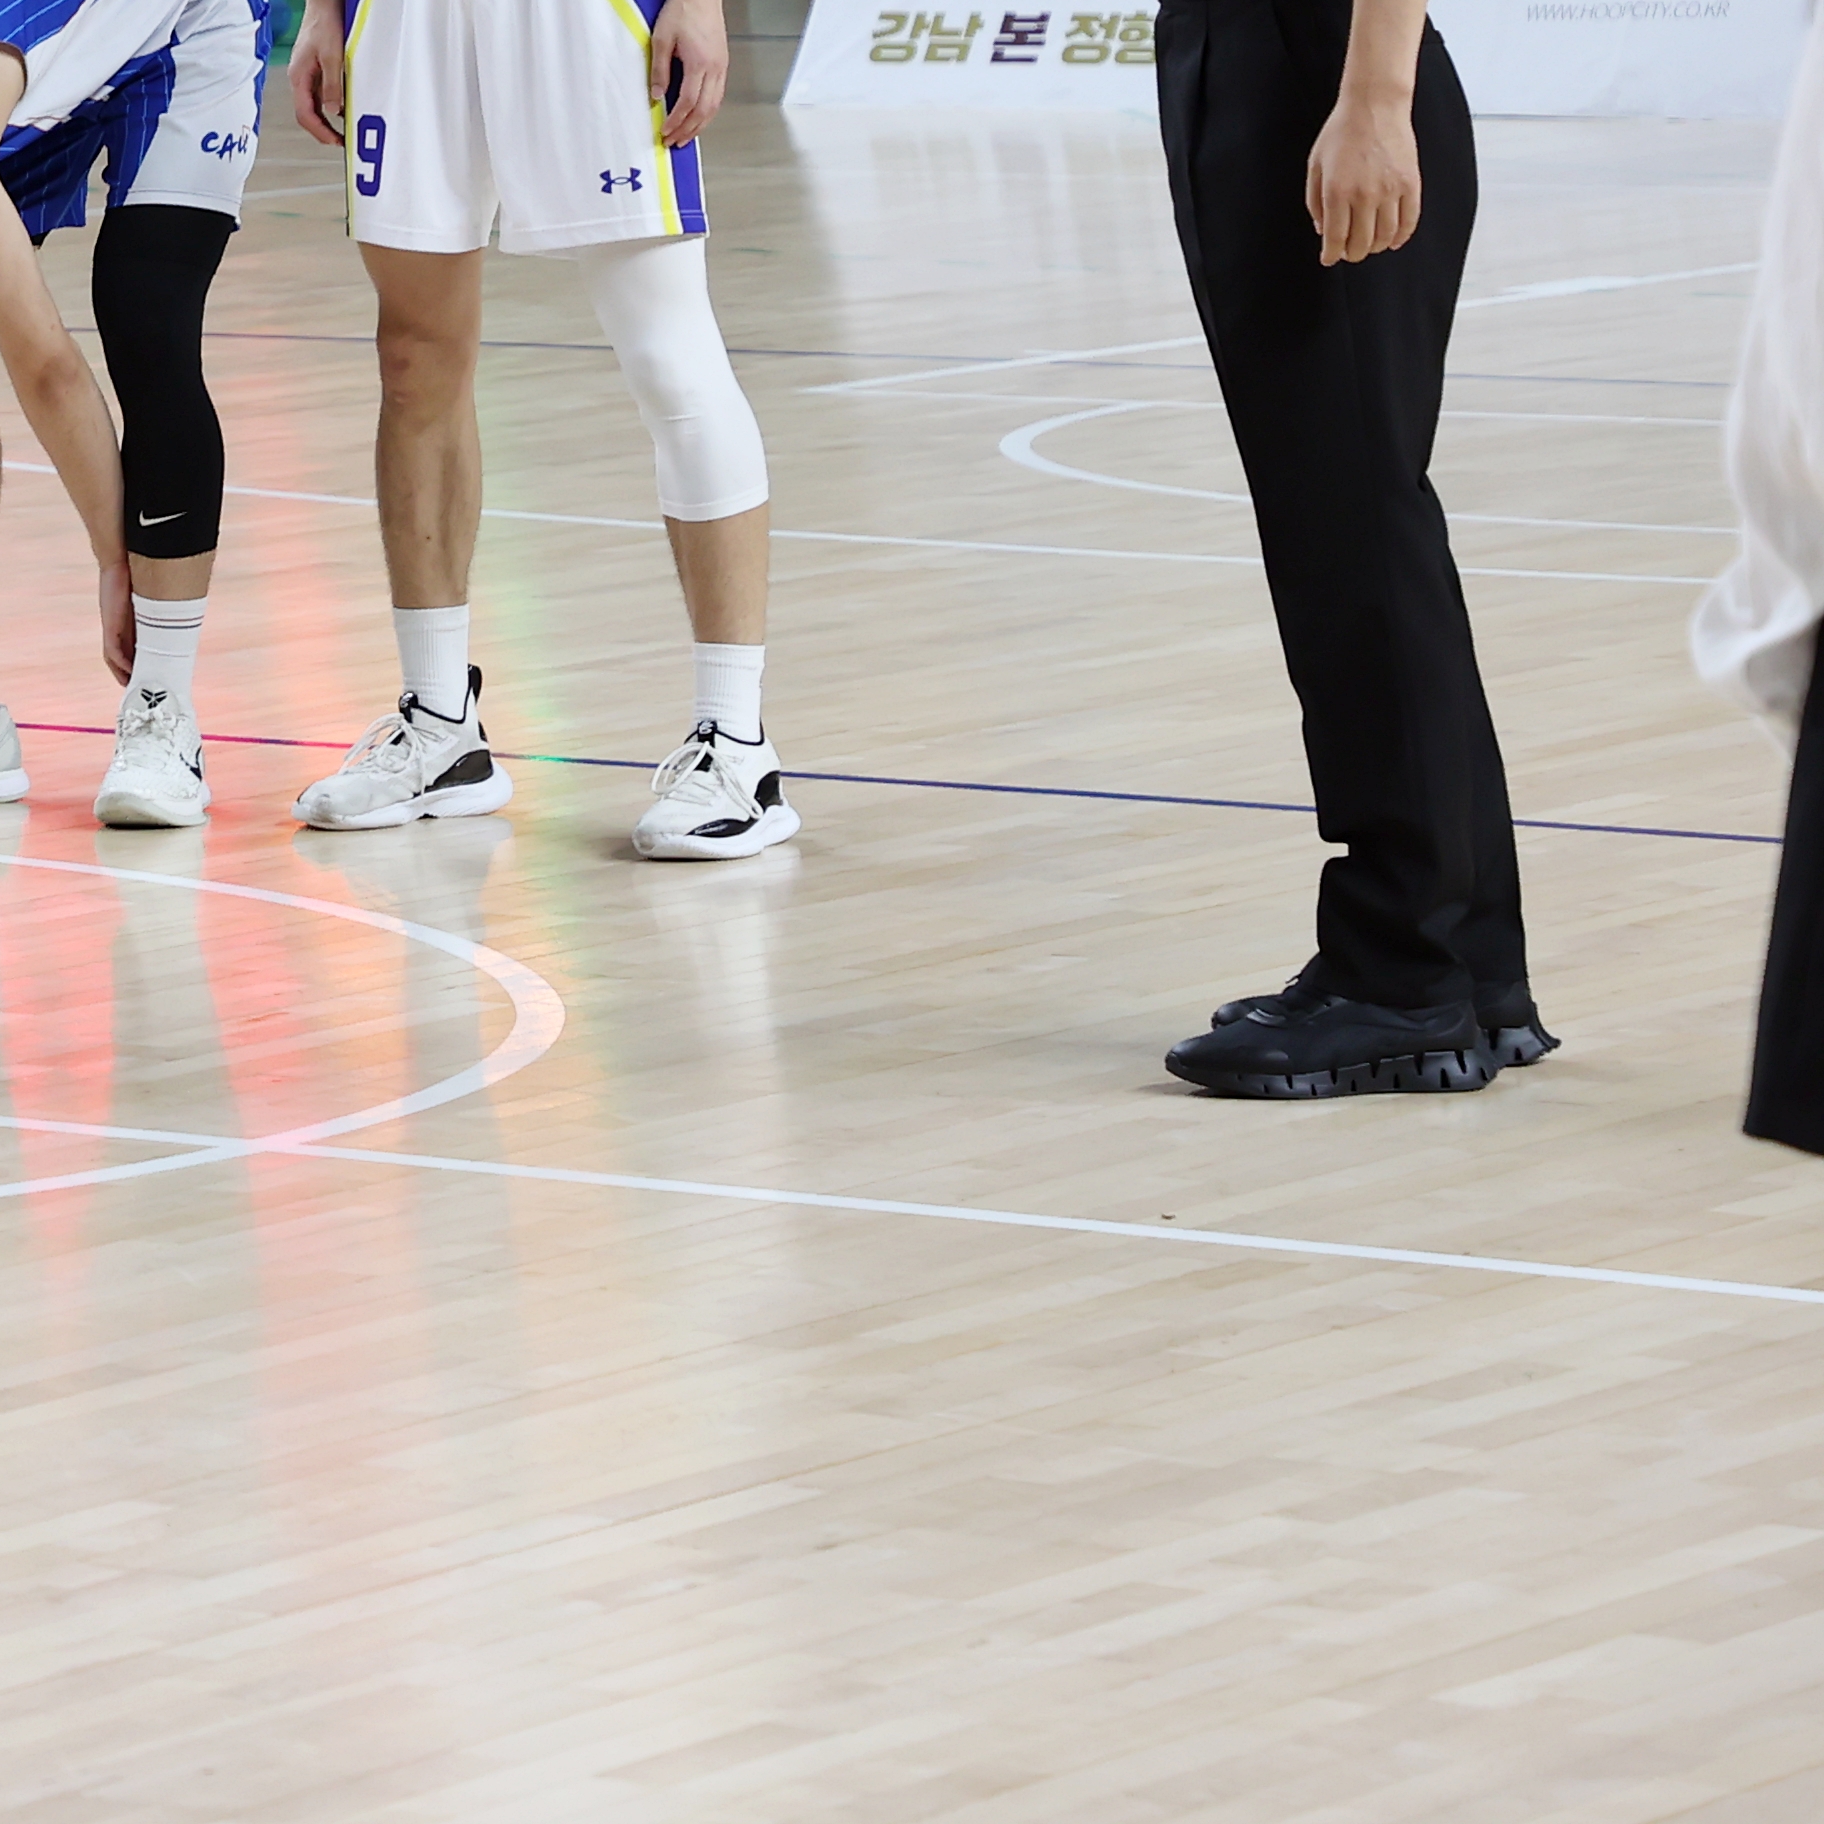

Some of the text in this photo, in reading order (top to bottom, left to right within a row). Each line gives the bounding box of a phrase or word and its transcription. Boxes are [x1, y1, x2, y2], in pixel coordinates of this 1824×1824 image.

[869, 9, 986, 64] 강남
[989, 10, 1052, 64] 본
[1526, 0, 1730, 23] WWW.HOOPCITY.CO.KR
[355, 114, 387, 197] 9
